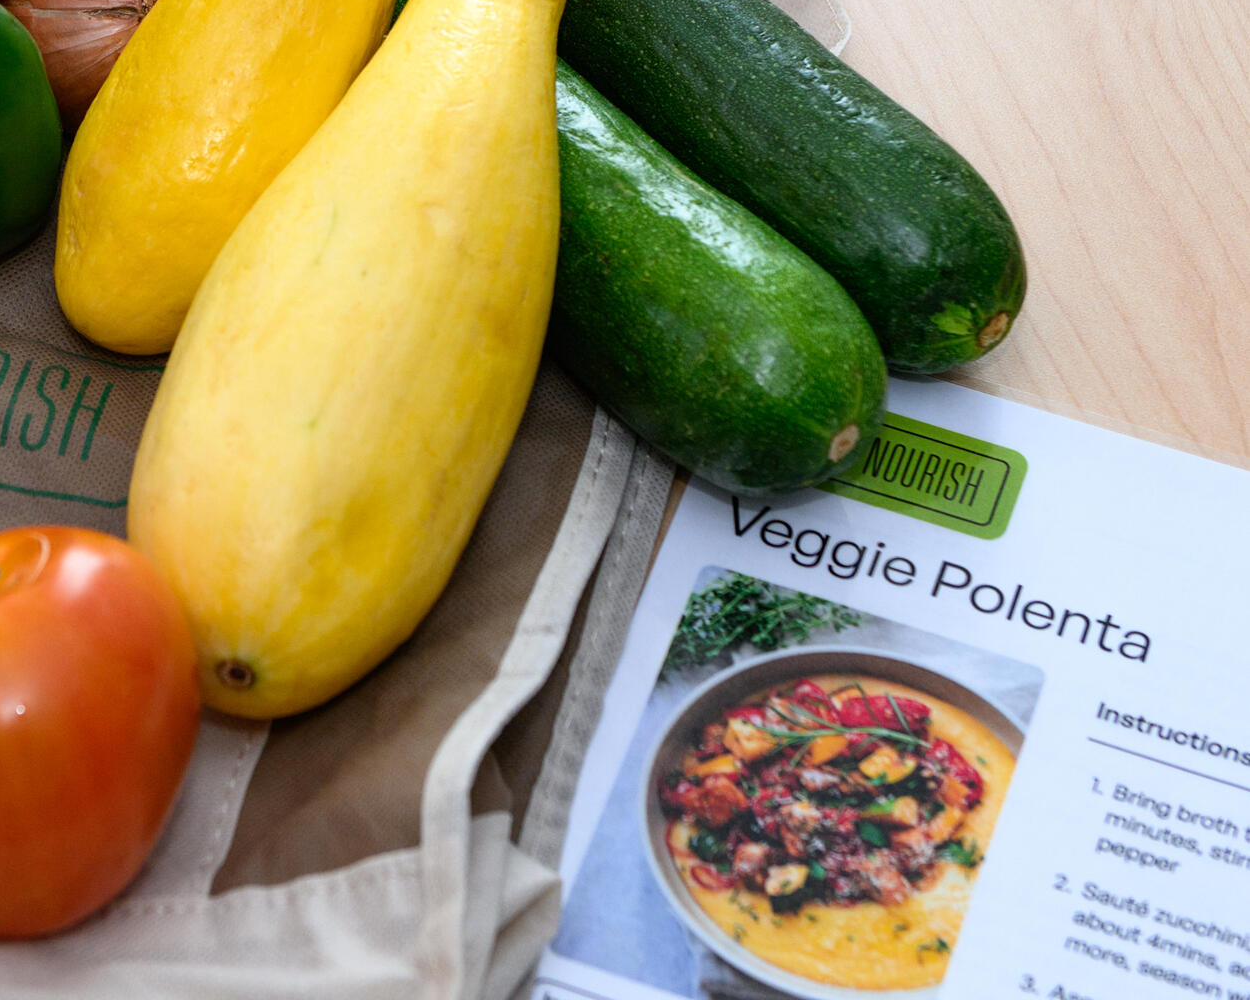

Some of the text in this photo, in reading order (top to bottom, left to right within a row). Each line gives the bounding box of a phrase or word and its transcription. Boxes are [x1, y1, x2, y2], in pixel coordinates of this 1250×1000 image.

[862, 436, 985, 507] NOURISH
[729, 495, 1152, 663] Veggie Polenta
[1113, 783, 1171, 819] Bring
[1177, 805, 1238, 838] broth
[1095, 837, 1180, 873] pepper
[1072, 910, 1141, 944] about
[1138, 960, 1221, 999] season
